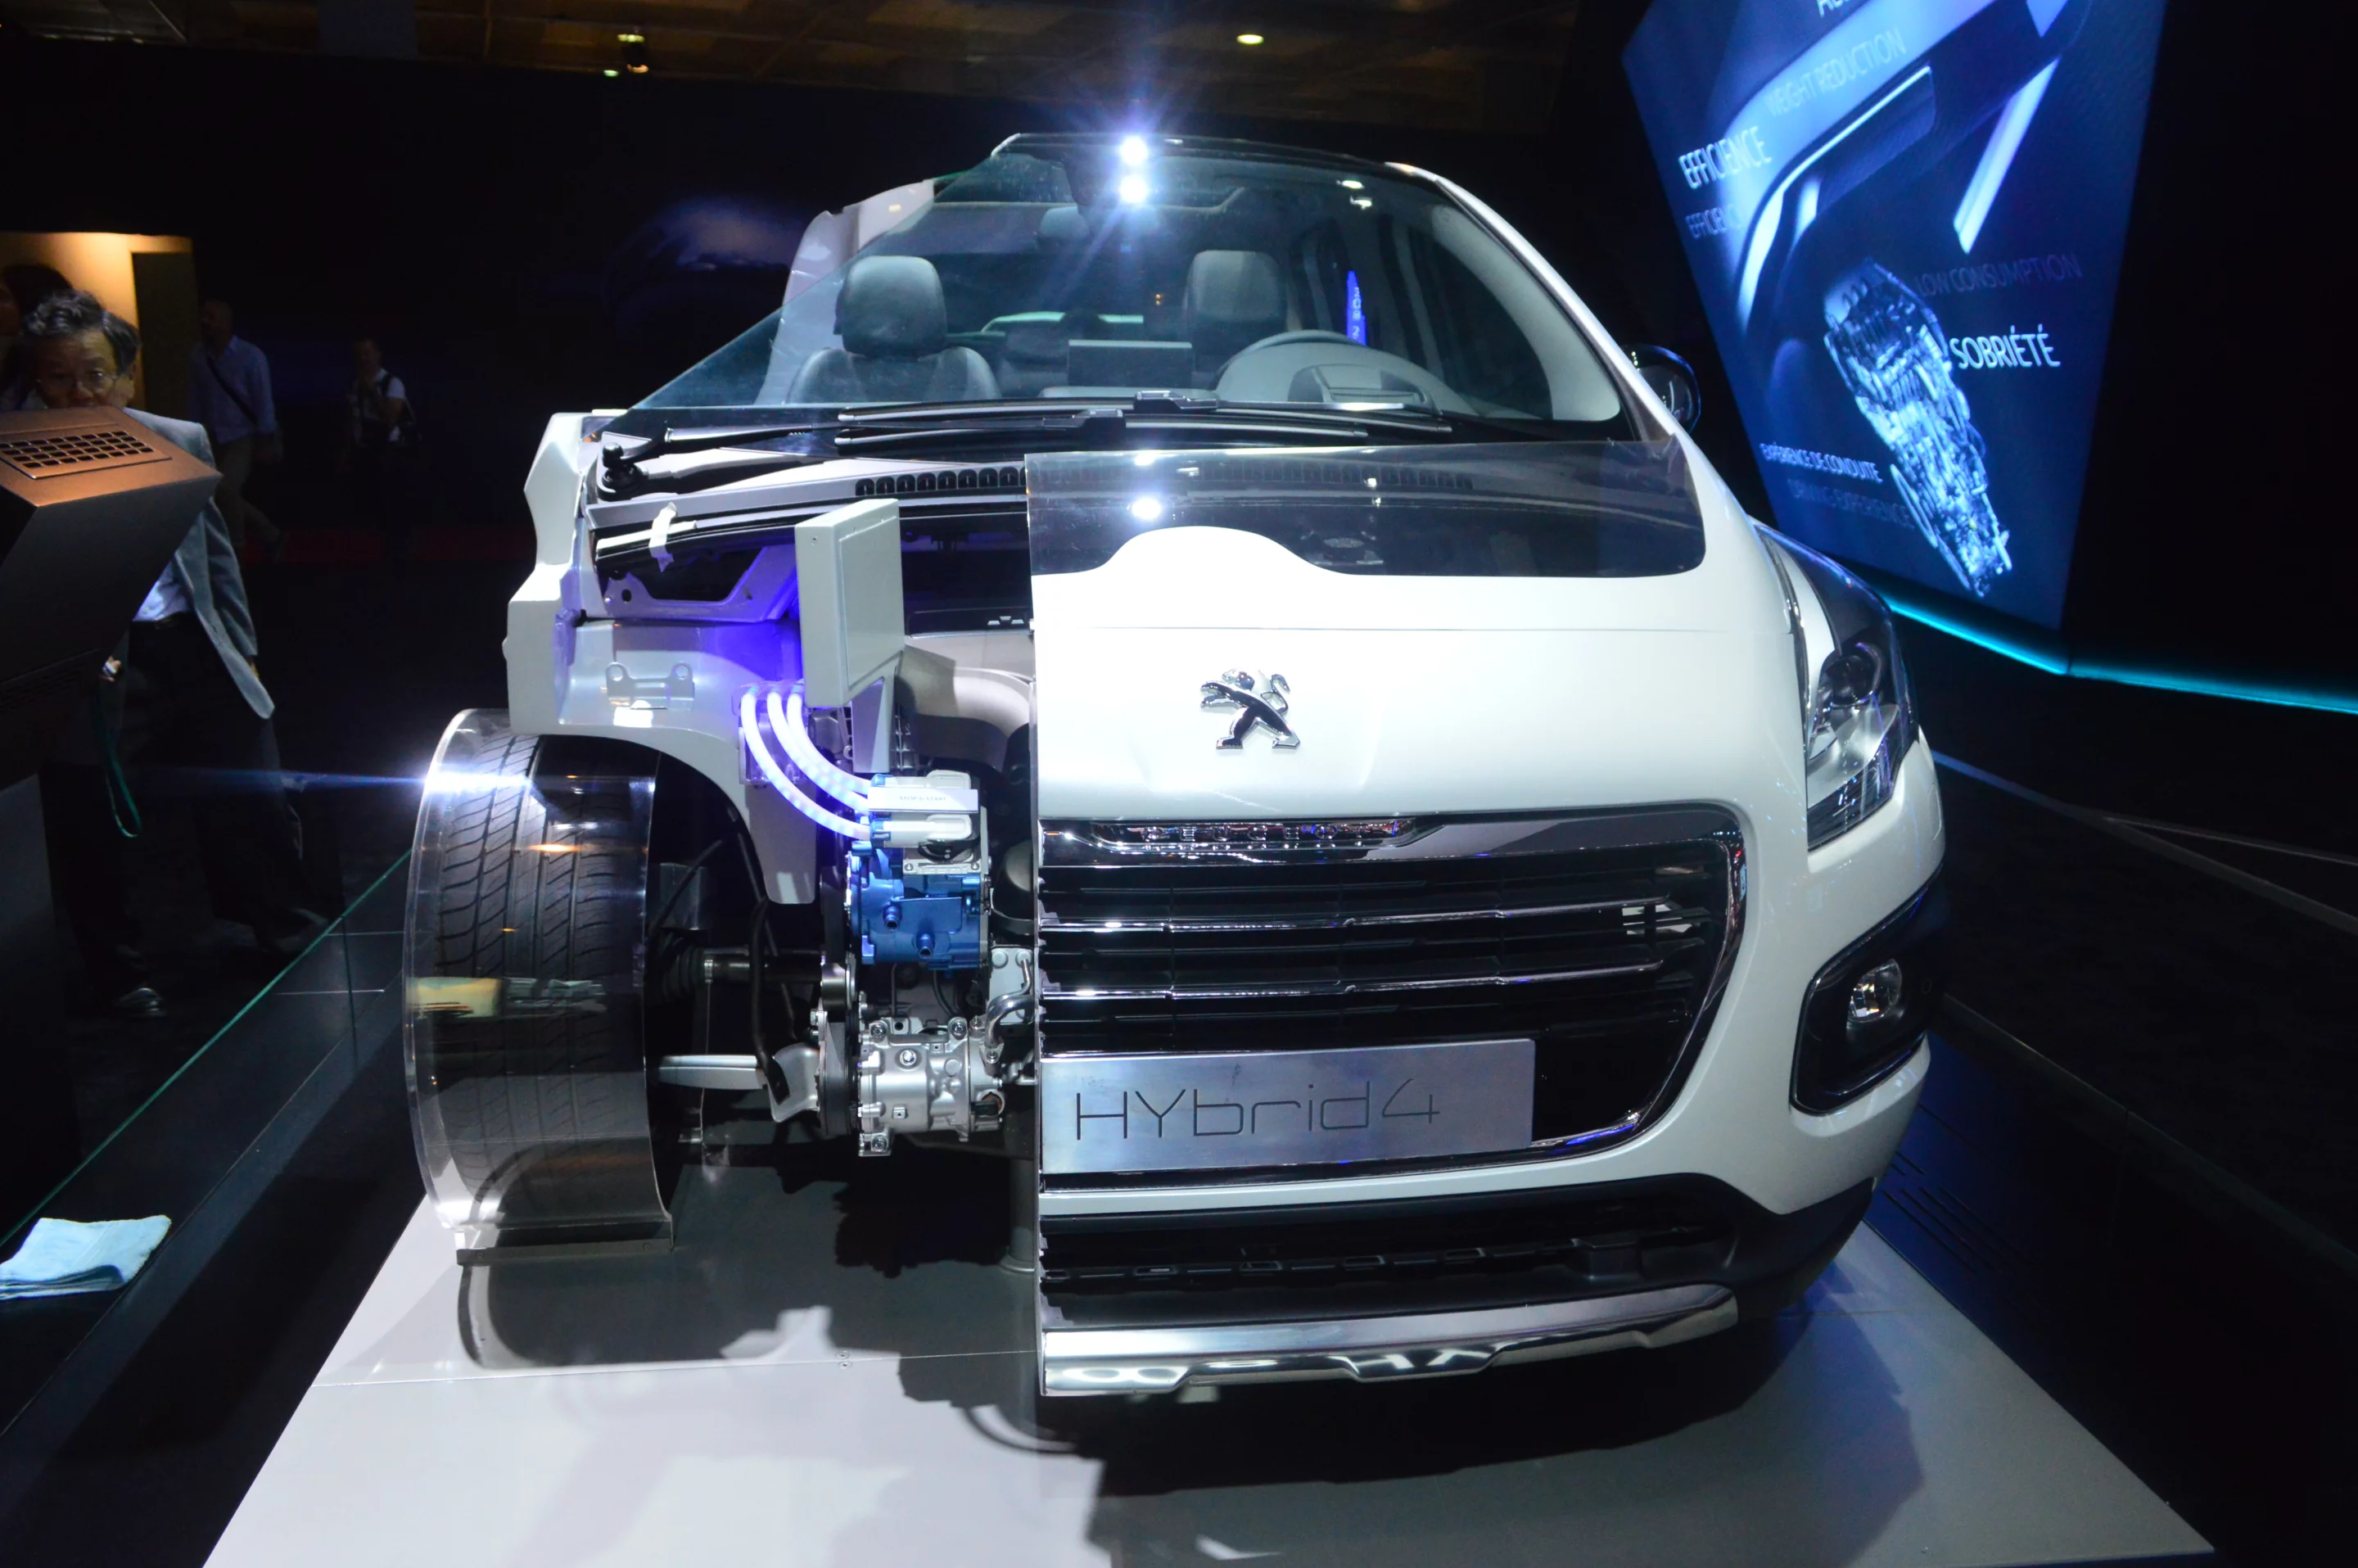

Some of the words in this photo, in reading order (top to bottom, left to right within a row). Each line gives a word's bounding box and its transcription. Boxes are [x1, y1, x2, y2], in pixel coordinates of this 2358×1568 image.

[1813, 25, 1907, 95] REDUCTION
[1678, 124, 1773, 190] EFFICIENCE
[1949, 252, 2084, 293] CONSUMPTION
[1949, 323, 2062, 369] SOBRIÉTÉ
[1823, 453, 1883, 484] CONDUITE
[1144, 821, 1366, 842] PEUGEOT
